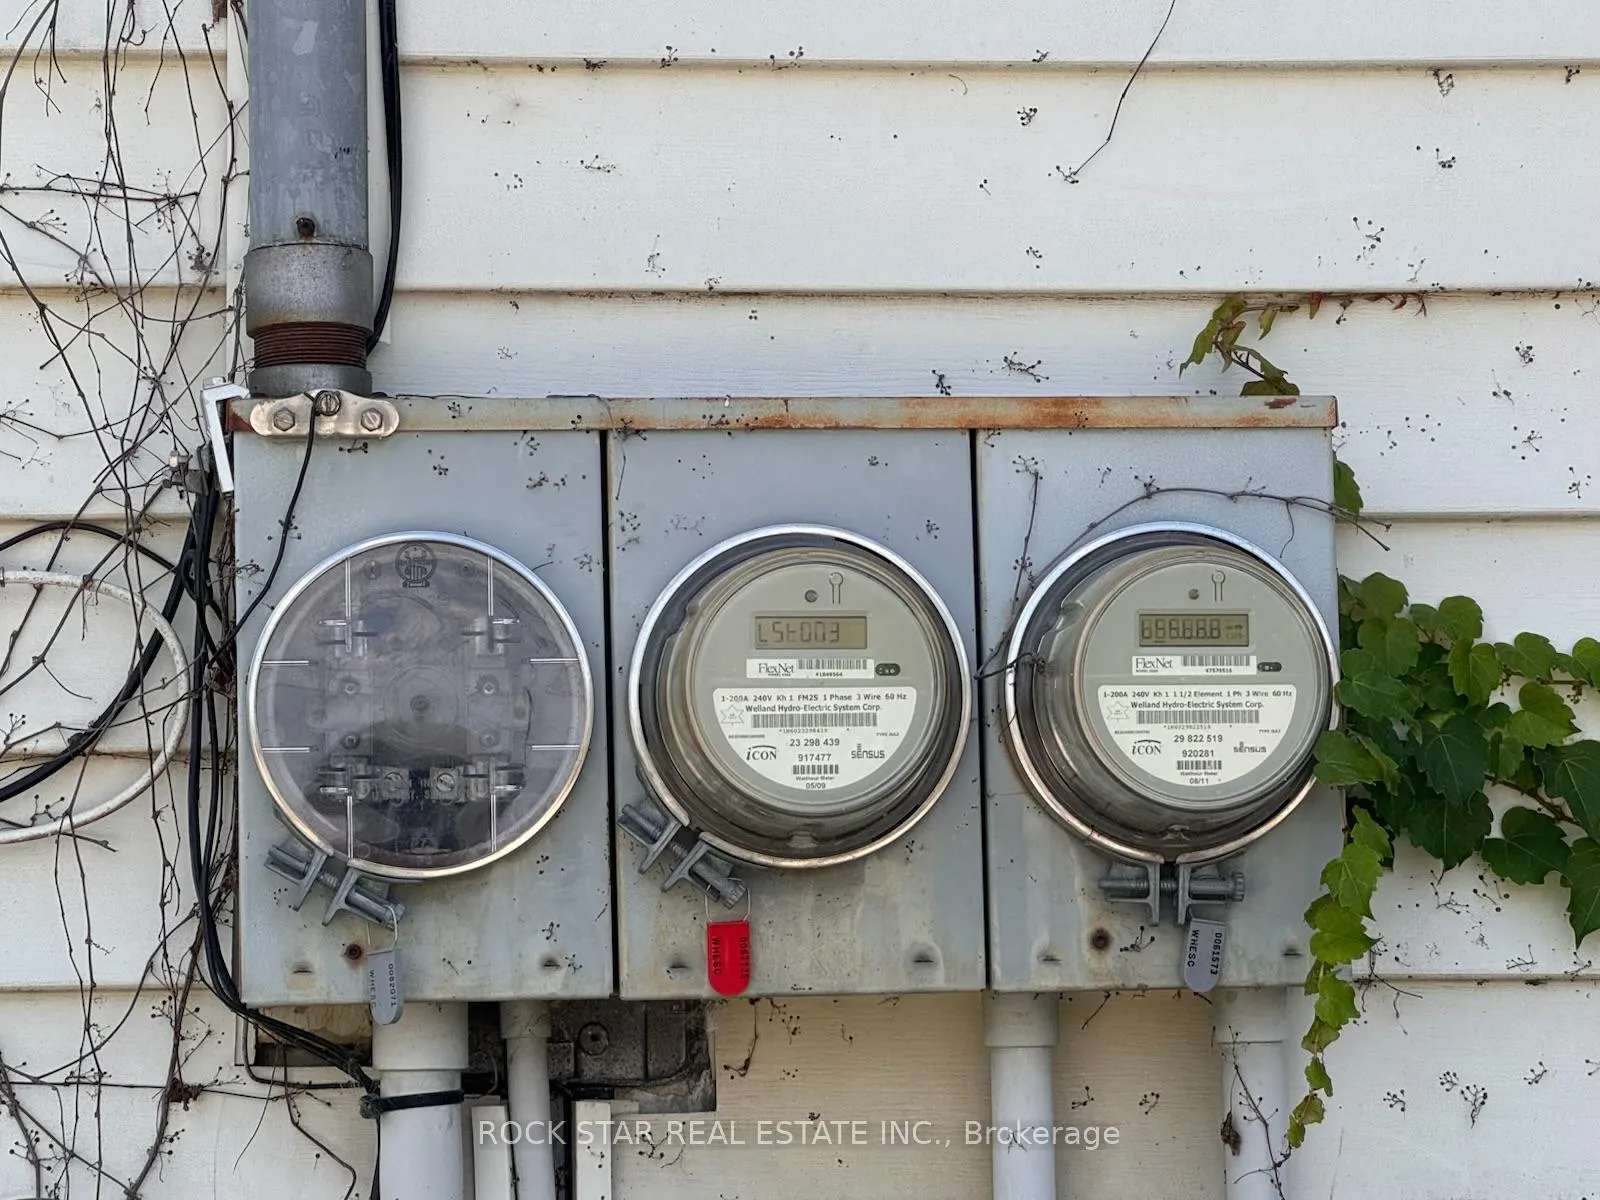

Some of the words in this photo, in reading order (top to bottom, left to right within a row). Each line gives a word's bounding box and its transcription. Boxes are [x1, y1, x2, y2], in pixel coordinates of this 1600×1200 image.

[758, 663, 795, 674] FlexNet
[1136, 658, 1173, 668] FlexNet
[778, 704, 831, 712] Hydro-Electric
[833, 704, 860, 712] System
[1162, 701, 1214, 709] Hydro-Electric
[1217, 701, 1243, 709] System
[1245, 701, 1264, 709] Corp.
[746, 746, 776, 760] iCON
[1132, 742, 1161, 754] iCON
[798, 754, 831, 762] 917477
[1188, 930, 1200, 967] WHESC
[1211, 932, 1222, 975] 0061573
